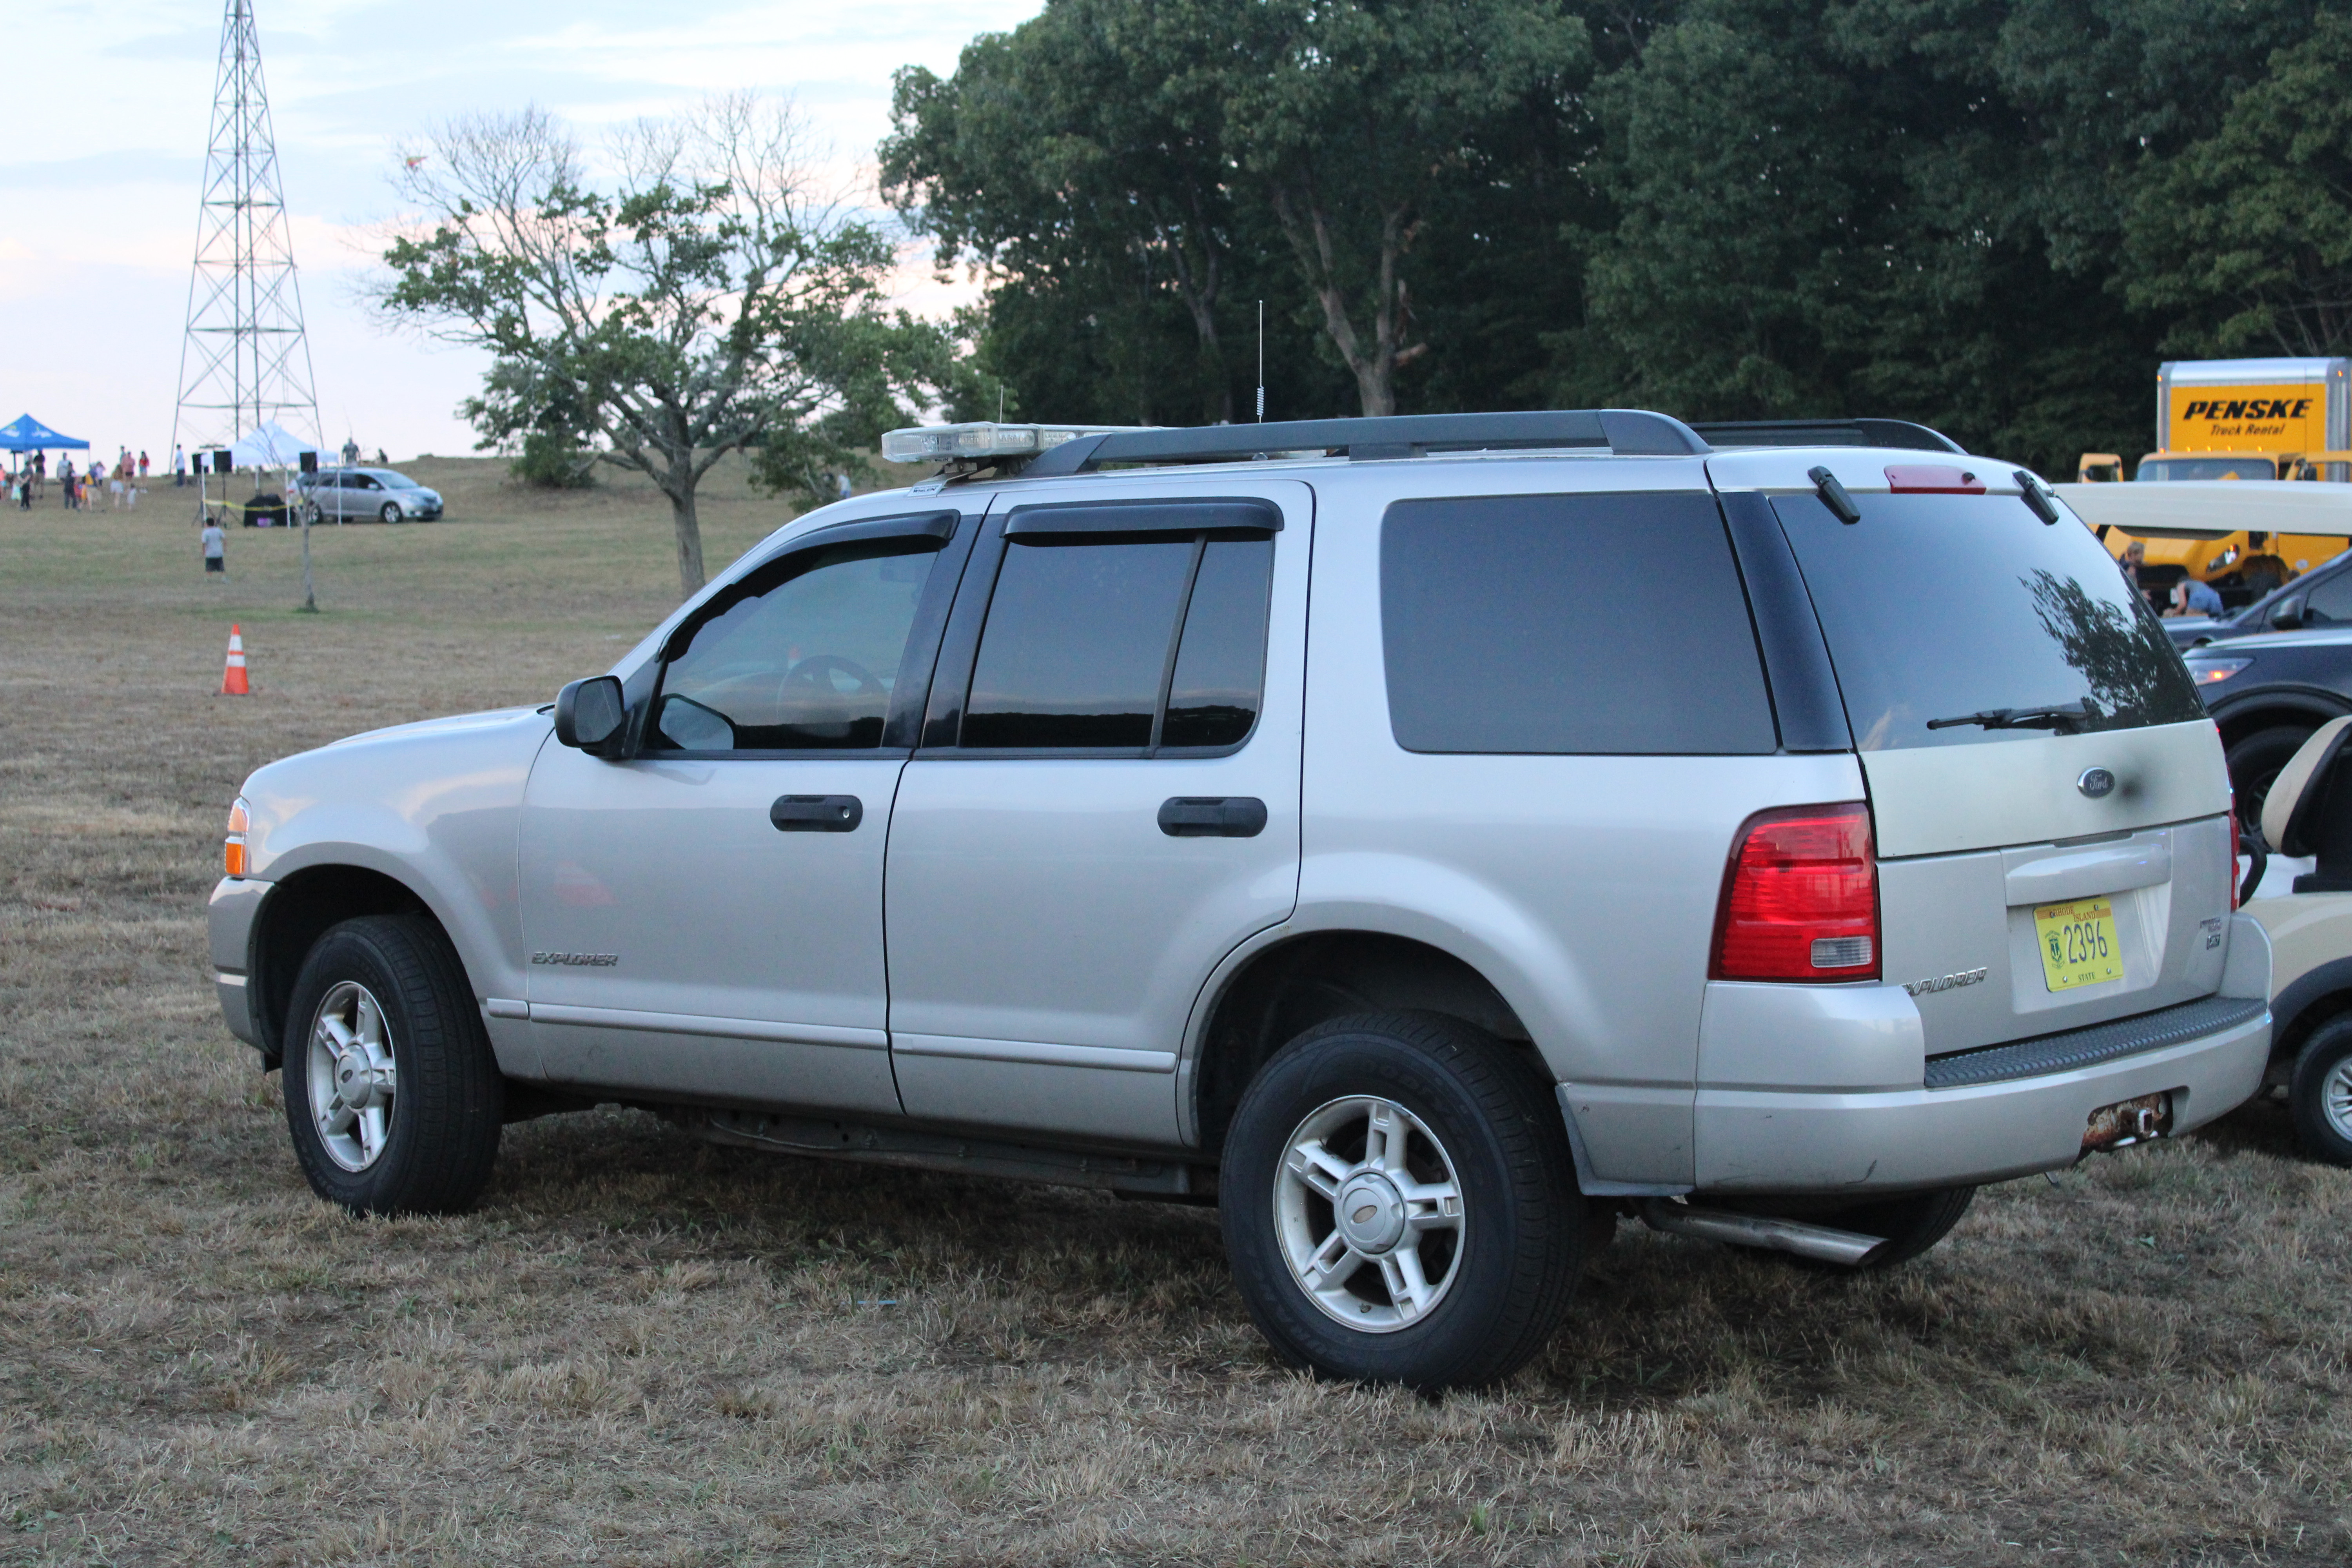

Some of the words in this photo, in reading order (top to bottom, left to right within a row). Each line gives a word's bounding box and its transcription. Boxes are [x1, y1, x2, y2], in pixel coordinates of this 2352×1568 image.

[2183, 398, 2313, 420] PENSKE
[2210, 424, 2242, 436] Truck
[2245, 423, 2285, 435] Rental
[2090, 773, 2109, 790] Ford
[2053, 906, 2074, 917] RHODE
[2073, 911, 2096, 922] ISLAND
[2063, 921, 2108, 964] 2396
[532, 951, 619, 966] EXPLORER
[1899, 966, 1987, 997] XPLORER
[2078, 972, 2096, 982] STATE
